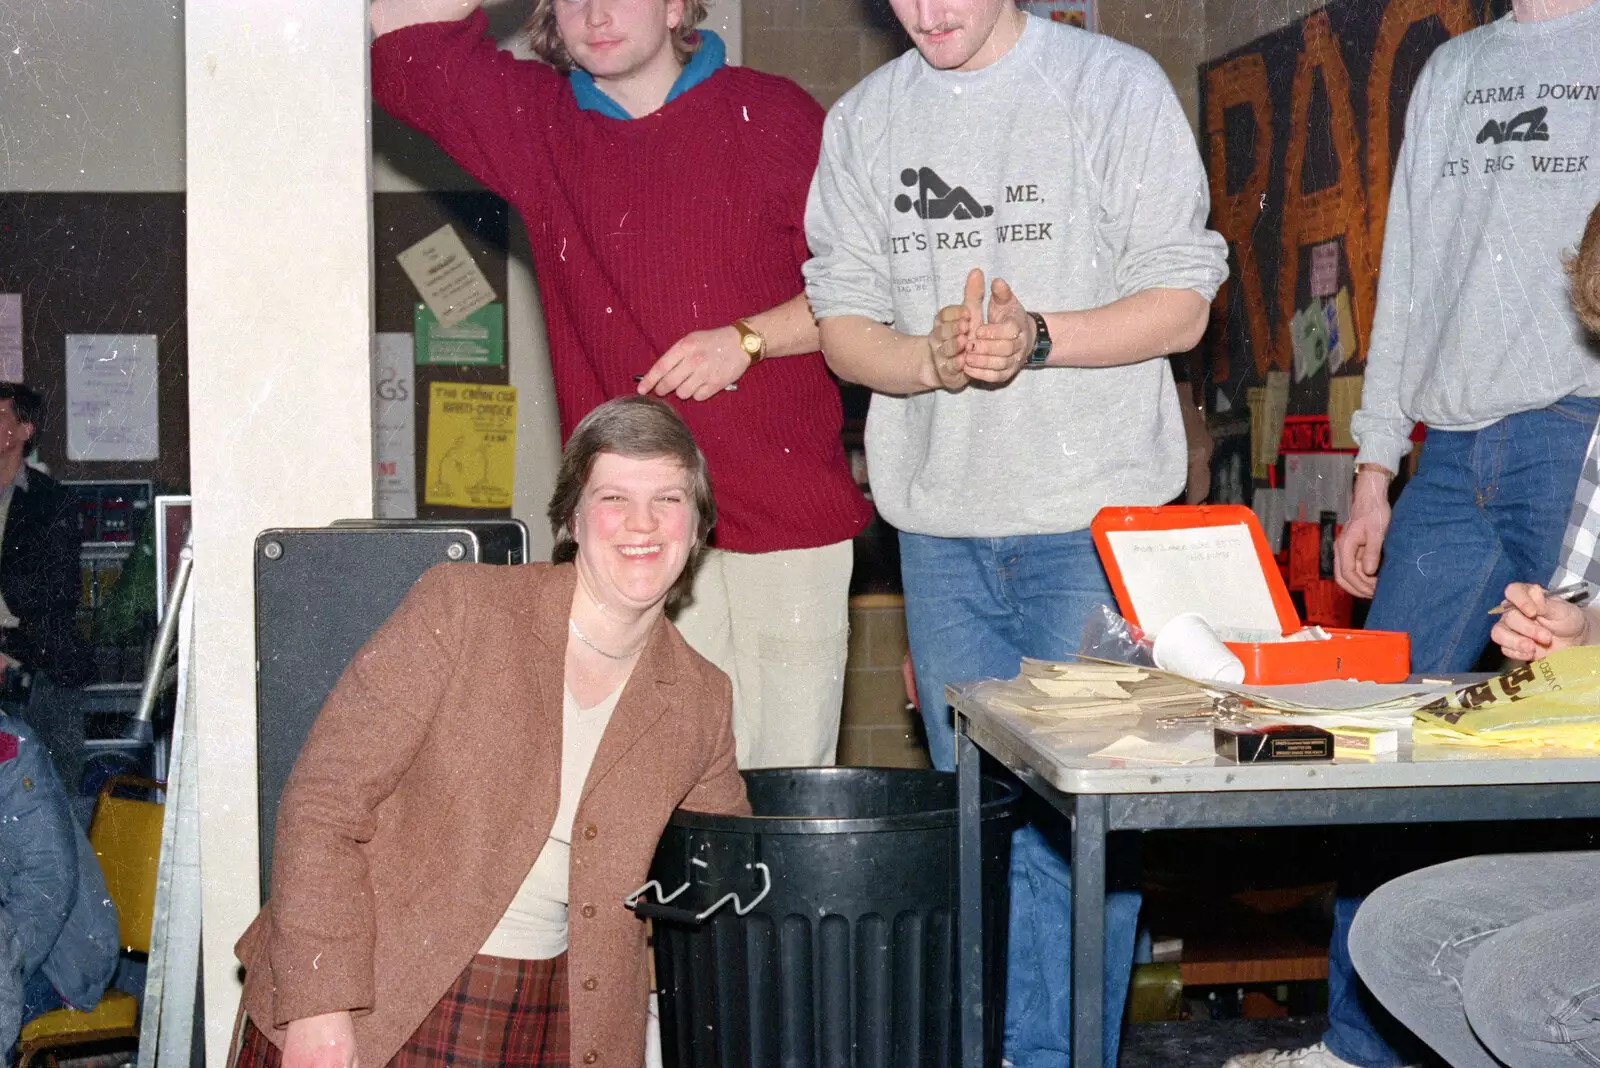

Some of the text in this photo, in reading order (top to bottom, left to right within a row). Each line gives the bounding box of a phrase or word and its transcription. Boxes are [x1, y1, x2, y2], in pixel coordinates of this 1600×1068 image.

[1531, 155, 1589, 173] WEEK
[1005, 184, 1045, 203] ME,
[892, 222, 1053, 254] IT'S RAG WEEK
